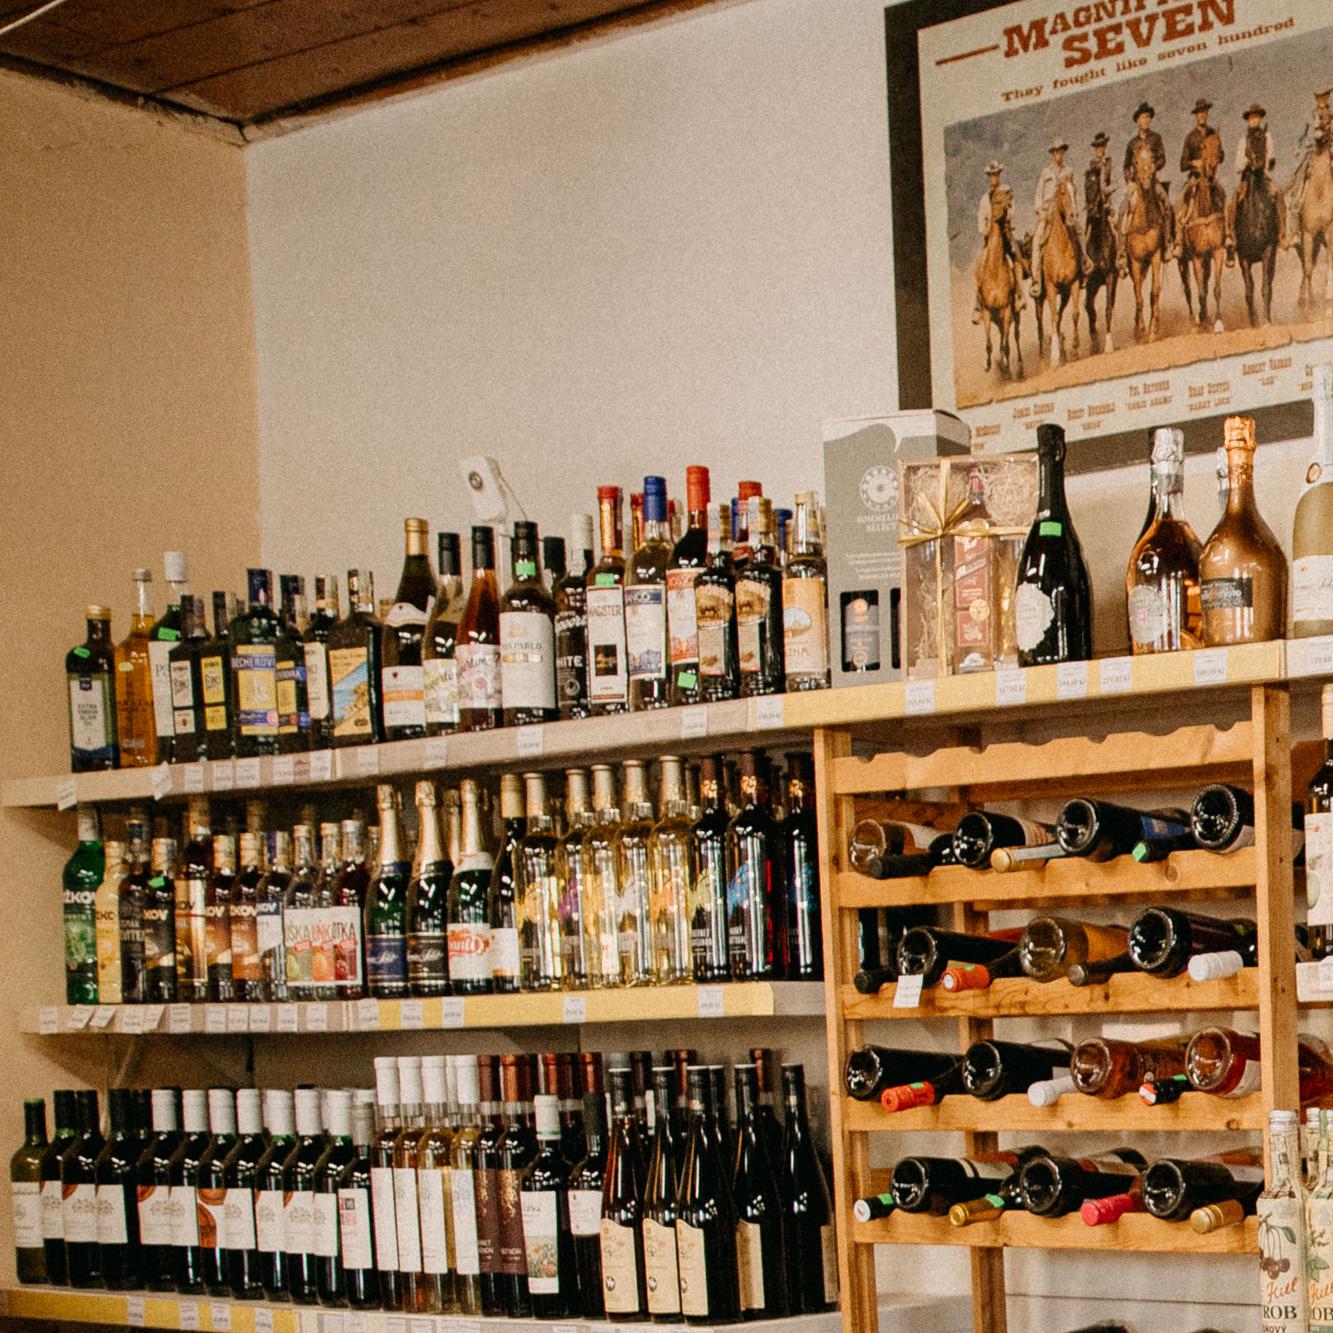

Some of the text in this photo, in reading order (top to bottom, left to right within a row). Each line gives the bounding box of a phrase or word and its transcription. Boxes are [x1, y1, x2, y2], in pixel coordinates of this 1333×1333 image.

[1002, 17, 1295, 102] They fought like seven hundred
[1063, 0, 1237, 69] SEVEN
